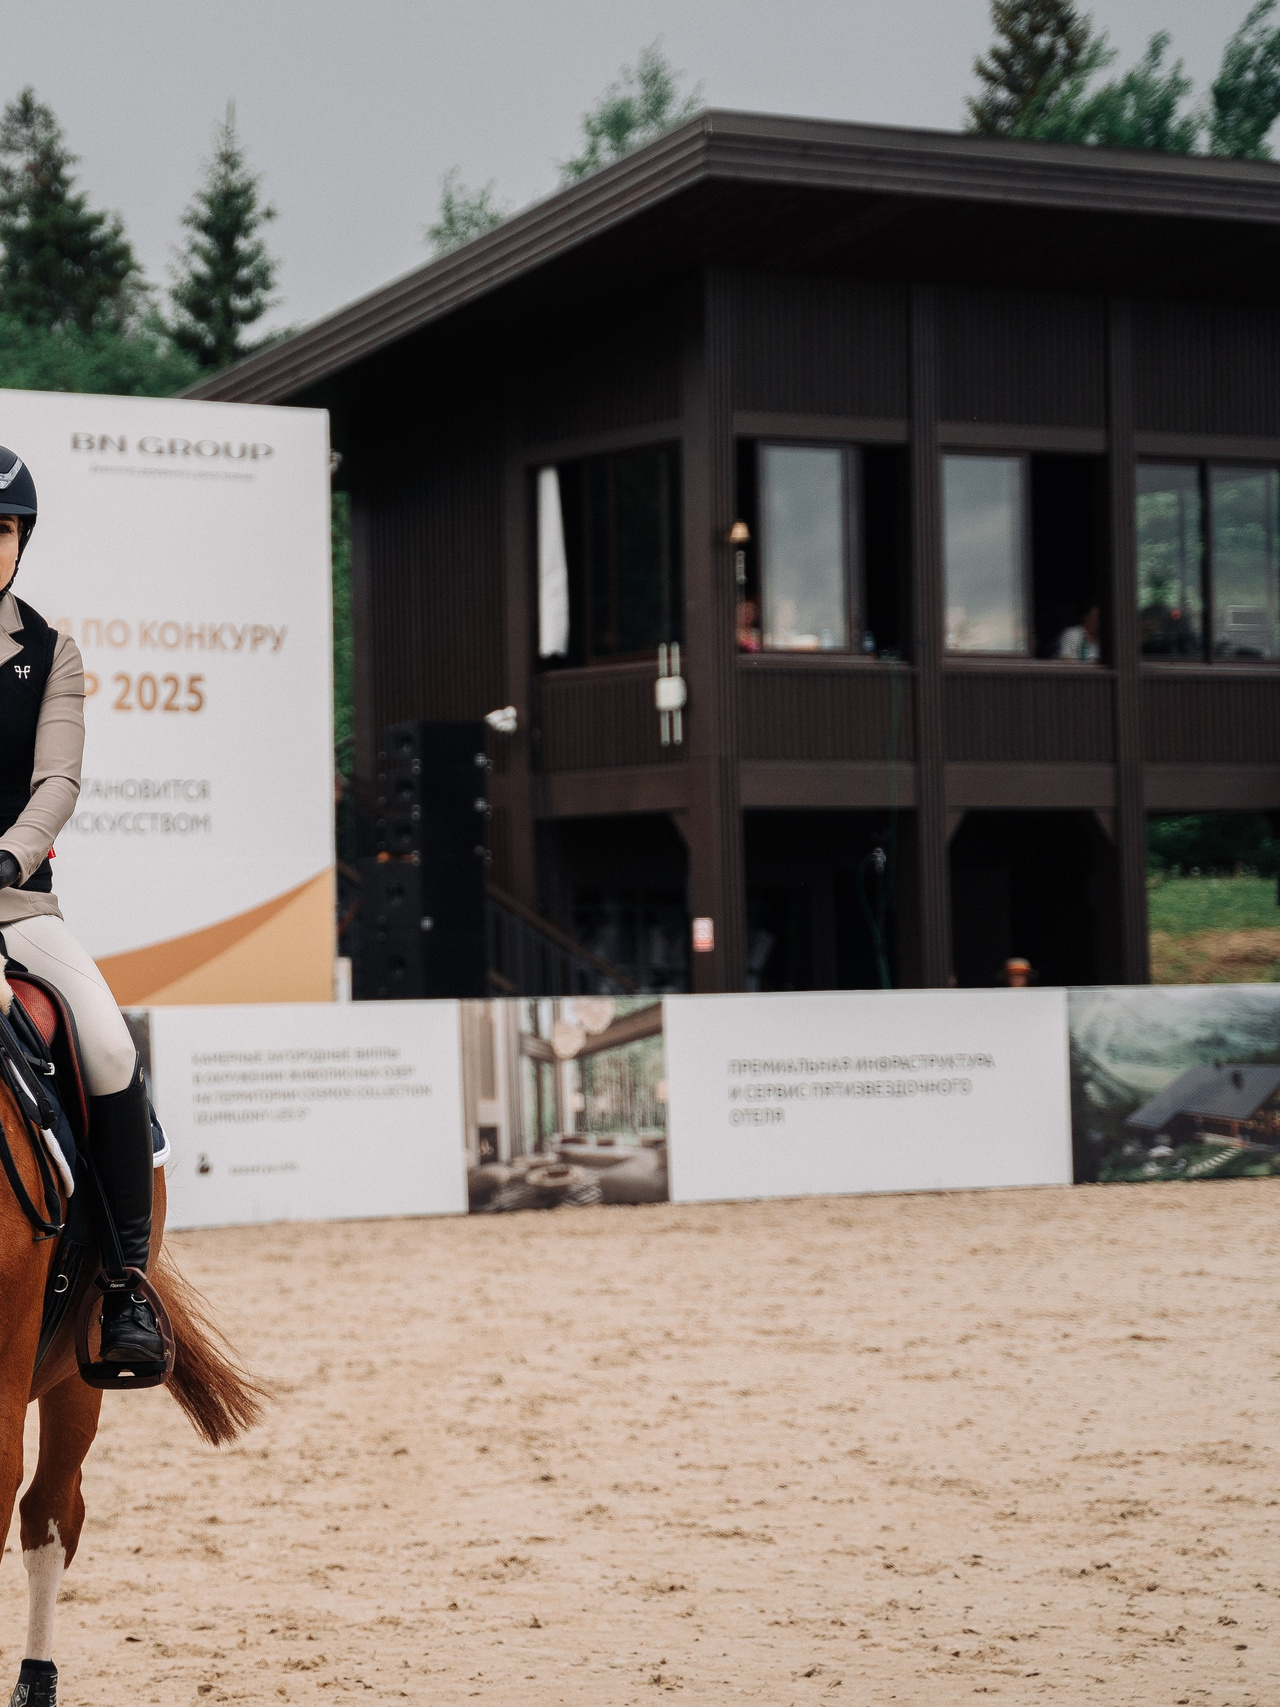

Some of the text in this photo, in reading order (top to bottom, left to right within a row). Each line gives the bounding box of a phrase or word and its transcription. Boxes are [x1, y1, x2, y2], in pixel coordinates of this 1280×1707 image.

[71, 432, 274, 461] BN GROUP
[81, 617, 131, 649] ПО
[138, 620, 288, 654] КОНКУРУ
[113, 672, 205, 714] 2025
[81, 778, 211, 801] ТАНОВИТСЯ
[727, 1053, 996, 1077] ПРЕМИАЛЬНАЯ ИНФРАСТРУКТУРА
[728, 1077, 973, 1102] И СЕРВИС ПЯТИЗВЕЗДОЧНОГО
[729, 1107, 785, 1127] ОТЕЛЯ
